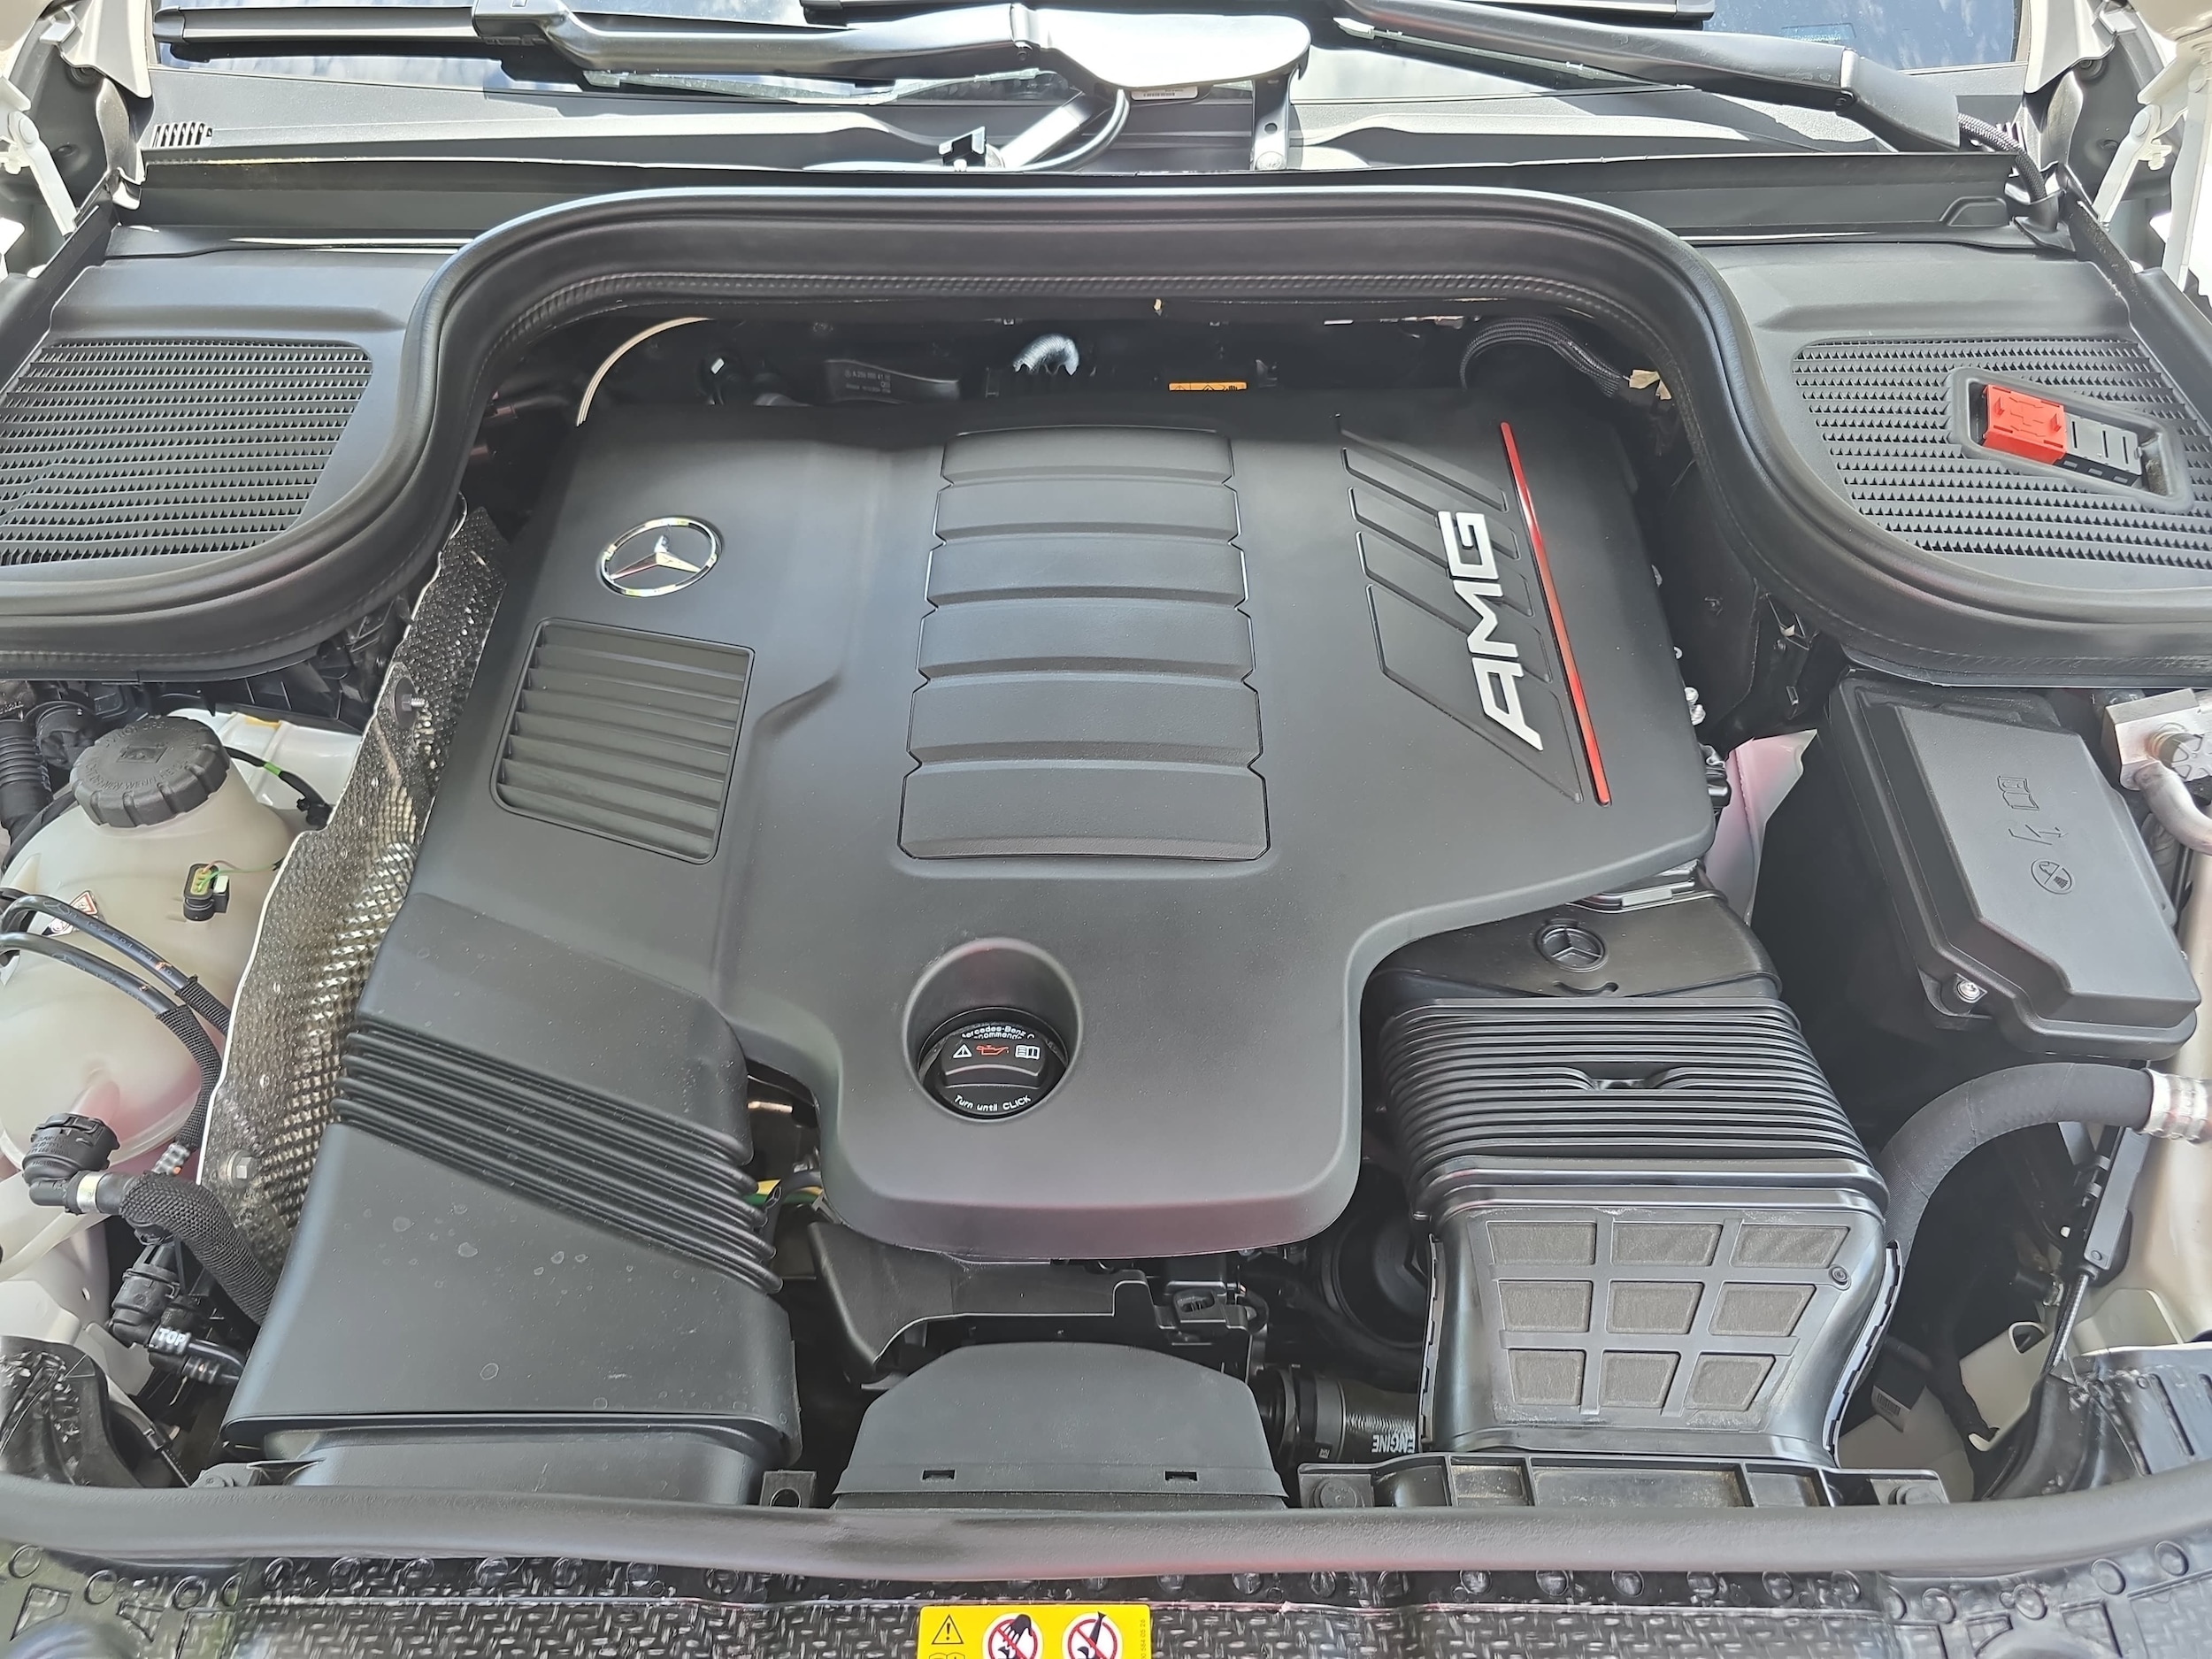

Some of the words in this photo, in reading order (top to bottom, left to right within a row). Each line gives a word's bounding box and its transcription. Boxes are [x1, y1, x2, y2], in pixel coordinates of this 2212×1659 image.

[1438, 511, 1543, 751] AMG
[954, 1094, 974, 1109] Turn
[977, 1102, 997, 1112] until
[1002, 1094, 1032, 1110] CLICK
[158, 1327, 187, 1346] TOP
[1371, 1432, 1416, 1454] ENGINE
